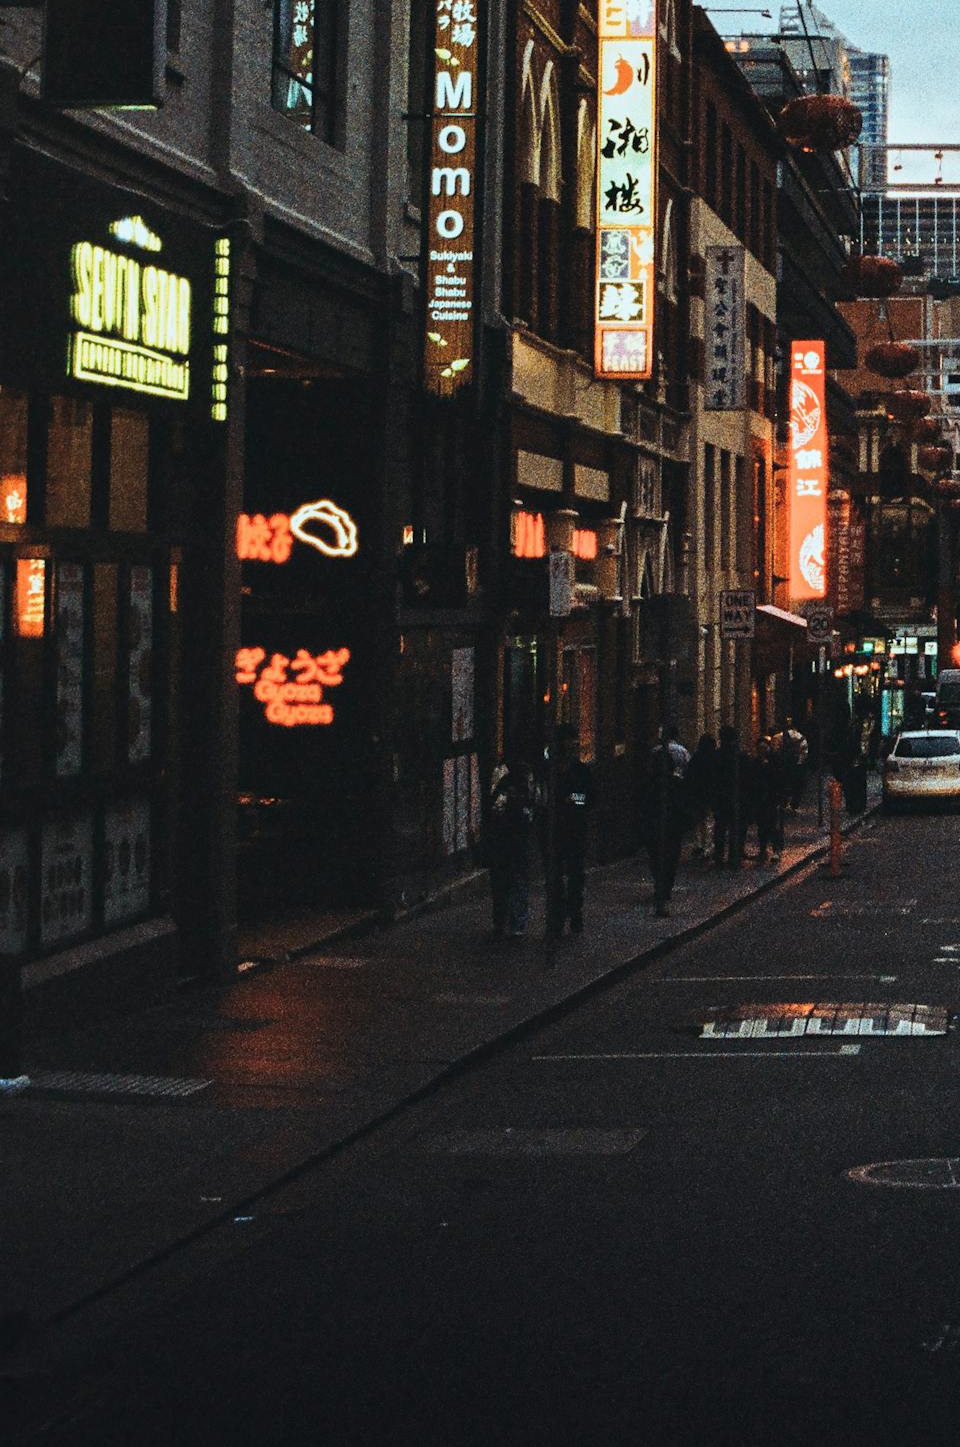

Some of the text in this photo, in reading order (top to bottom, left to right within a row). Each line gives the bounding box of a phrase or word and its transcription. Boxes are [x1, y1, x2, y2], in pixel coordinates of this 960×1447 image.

[431, 70, 472, 240] Momo
[430, 250, 473, 263] Sukiyaki
[435, 274, 466, 286] Shabu
[435, 286, 466, 298] Shabu
[428, 300, 472, 311] Japanese
[431, 310, 469, 321] Cuisine
[725, 595, 749, 605] ONE
[724, 610, 748, 620] WAY
[811, 618, 829, 632] 20
[235, 647, 351, 686] ぎょうざ
[254, 680, 322, 703] Gyoza
[265, 701, 334, 727] Gyoza
